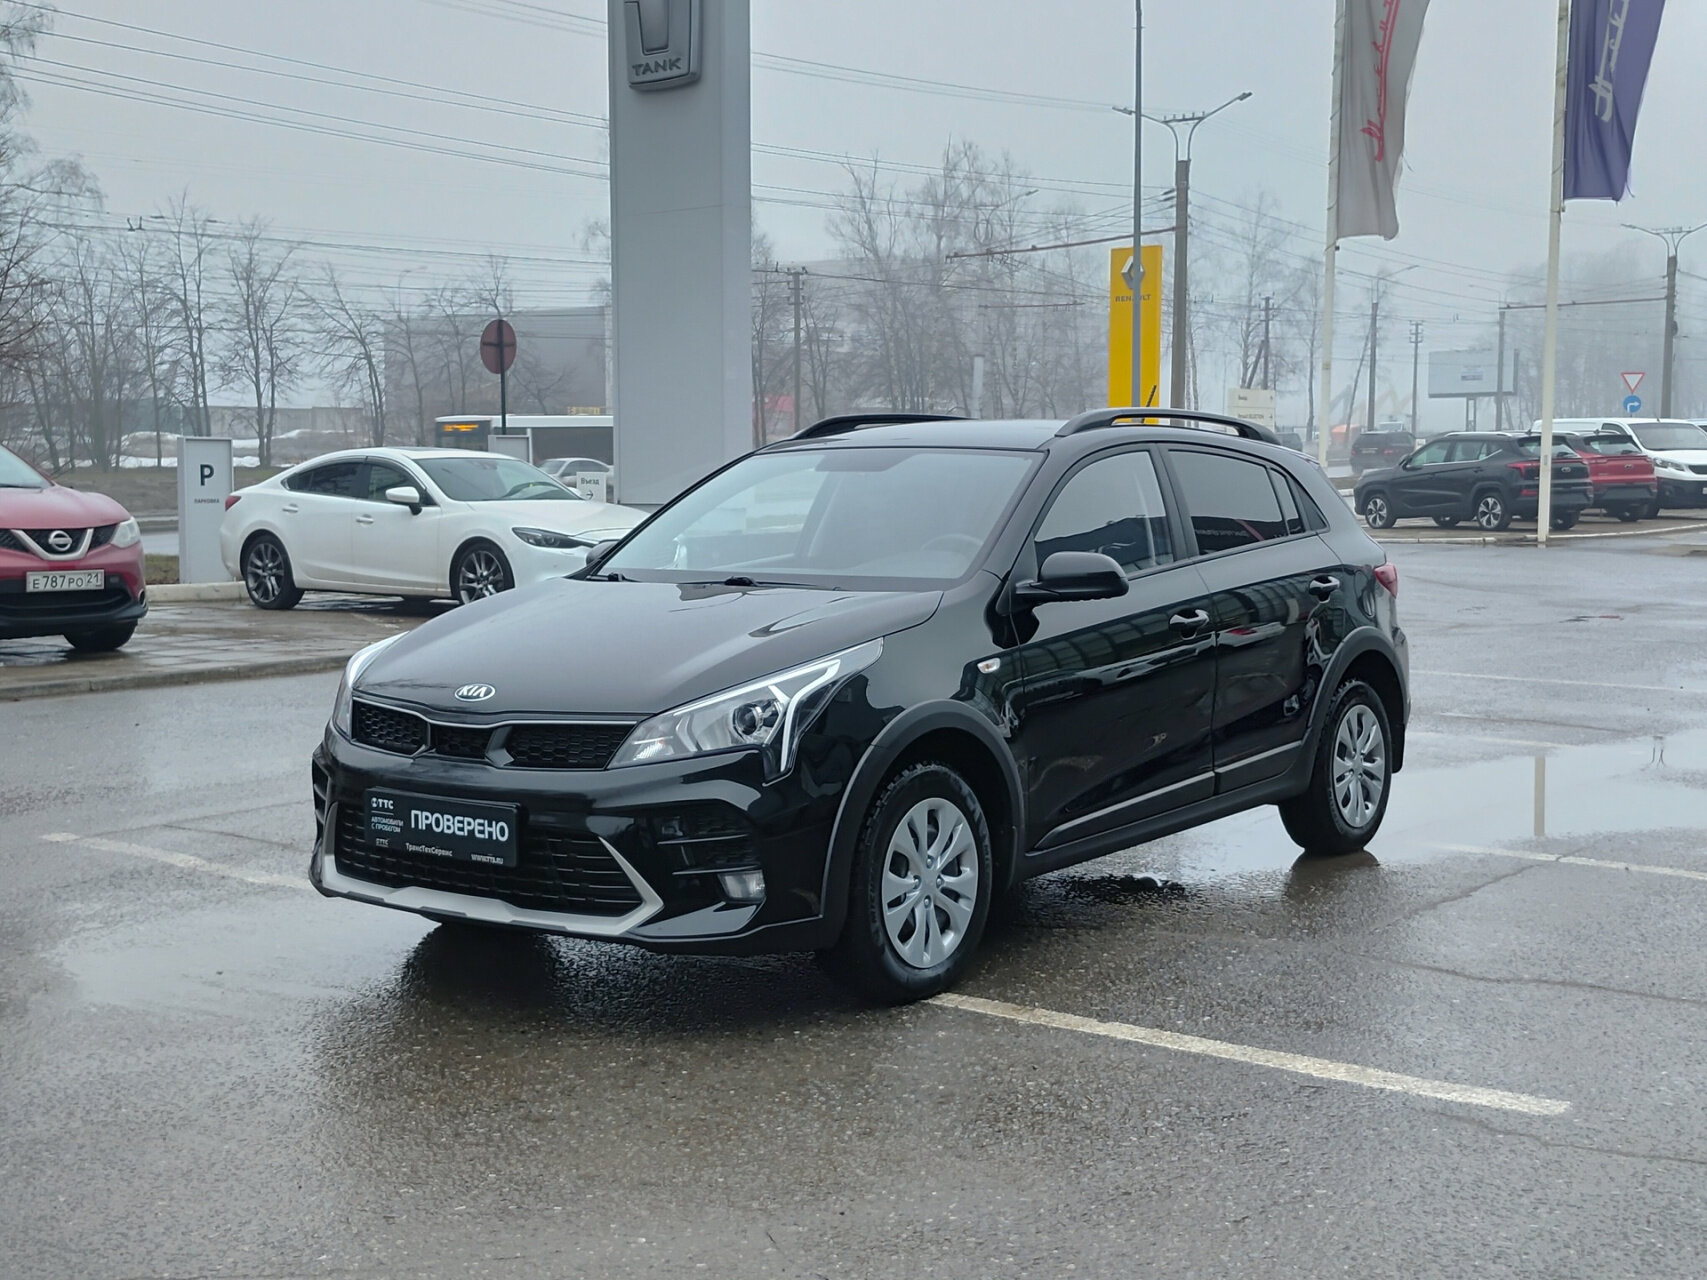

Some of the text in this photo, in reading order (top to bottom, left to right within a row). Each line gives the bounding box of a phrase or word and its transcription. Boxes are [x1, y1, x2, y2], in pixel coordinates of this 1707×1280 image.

[632, 57, 682, 77] TANK
[1115, 293, 1152, 303] RENLT
[458, 685, 488, 698] KIA
[411, 810, 509, 842] ПРОВЕРЕНО
[405, 842, 453, 857] ТрансТехСервис
